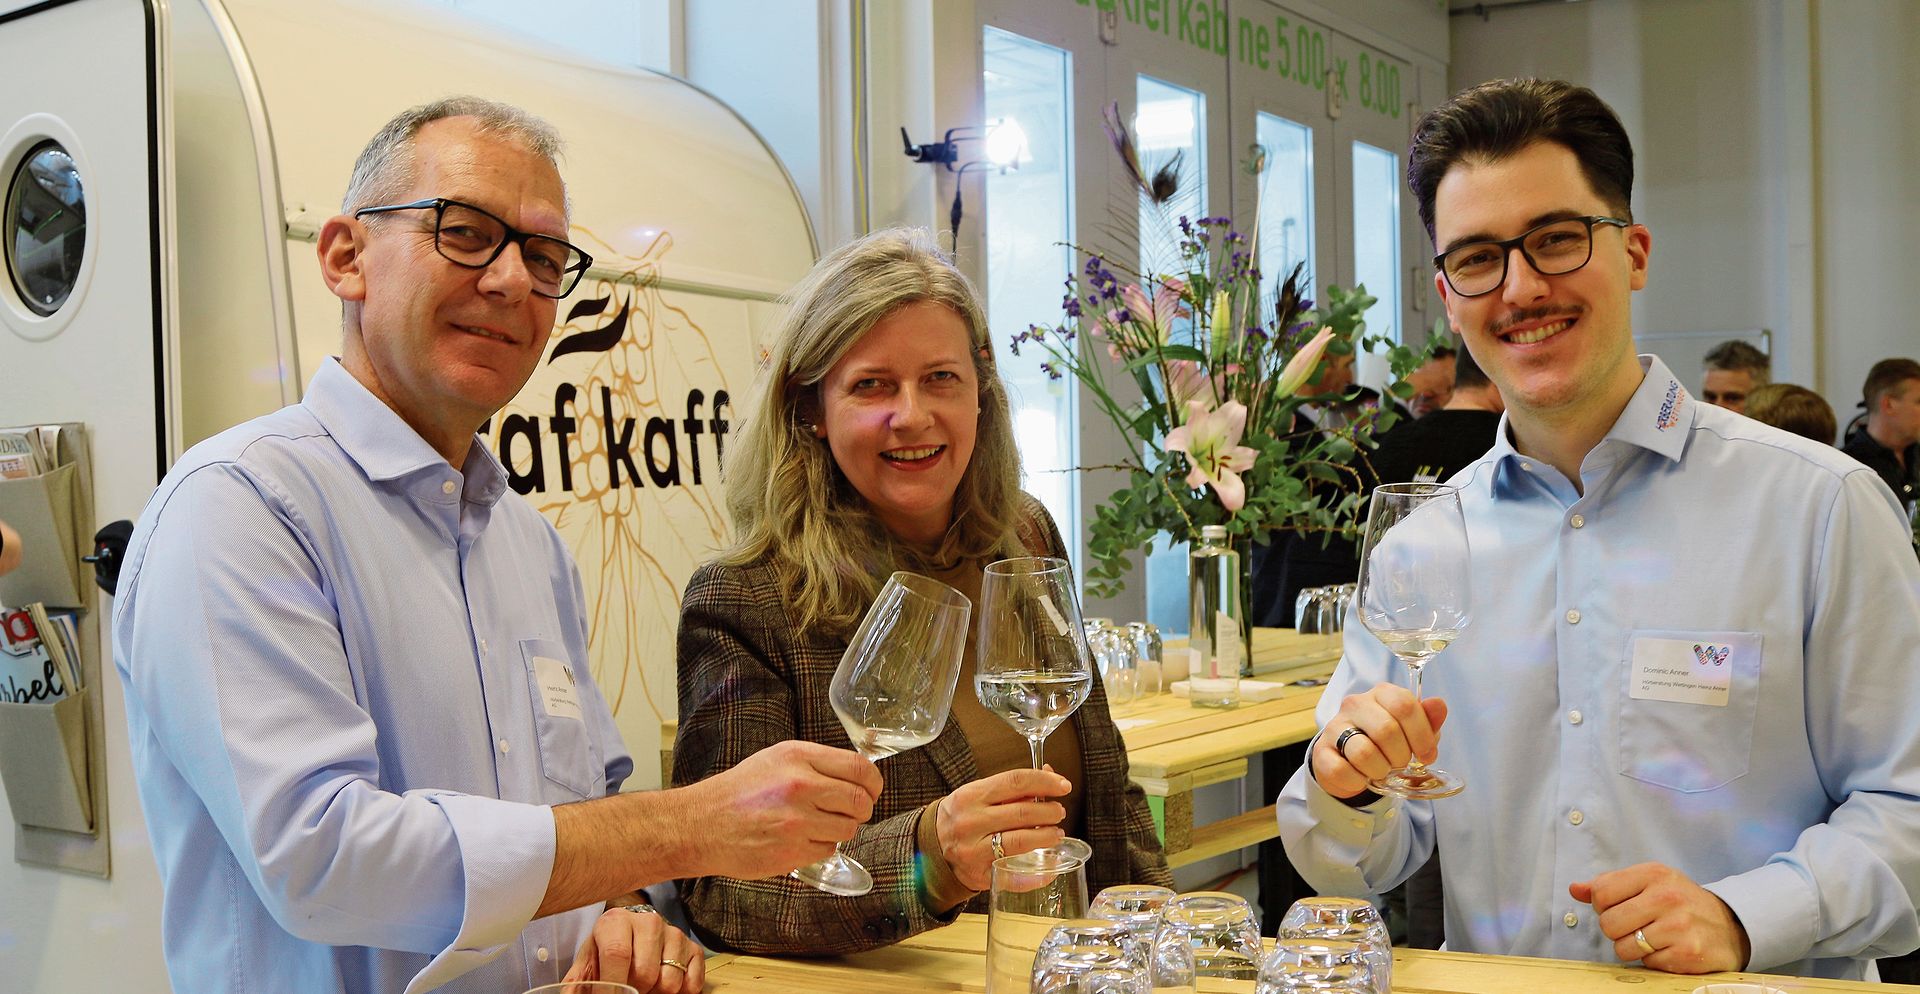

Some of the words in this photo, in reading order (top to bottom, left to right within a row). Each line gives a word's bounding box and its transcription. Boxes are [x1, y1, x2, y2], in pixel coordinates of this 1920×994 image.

[1239, 17, 1270, 71] ne
[1276, 16, 1325, 91] 5.00
[1359, 53, 1401, 119] 8.00
[480, 382, 577, 496] af
[1643, 666, 1668, 675] Dominic
